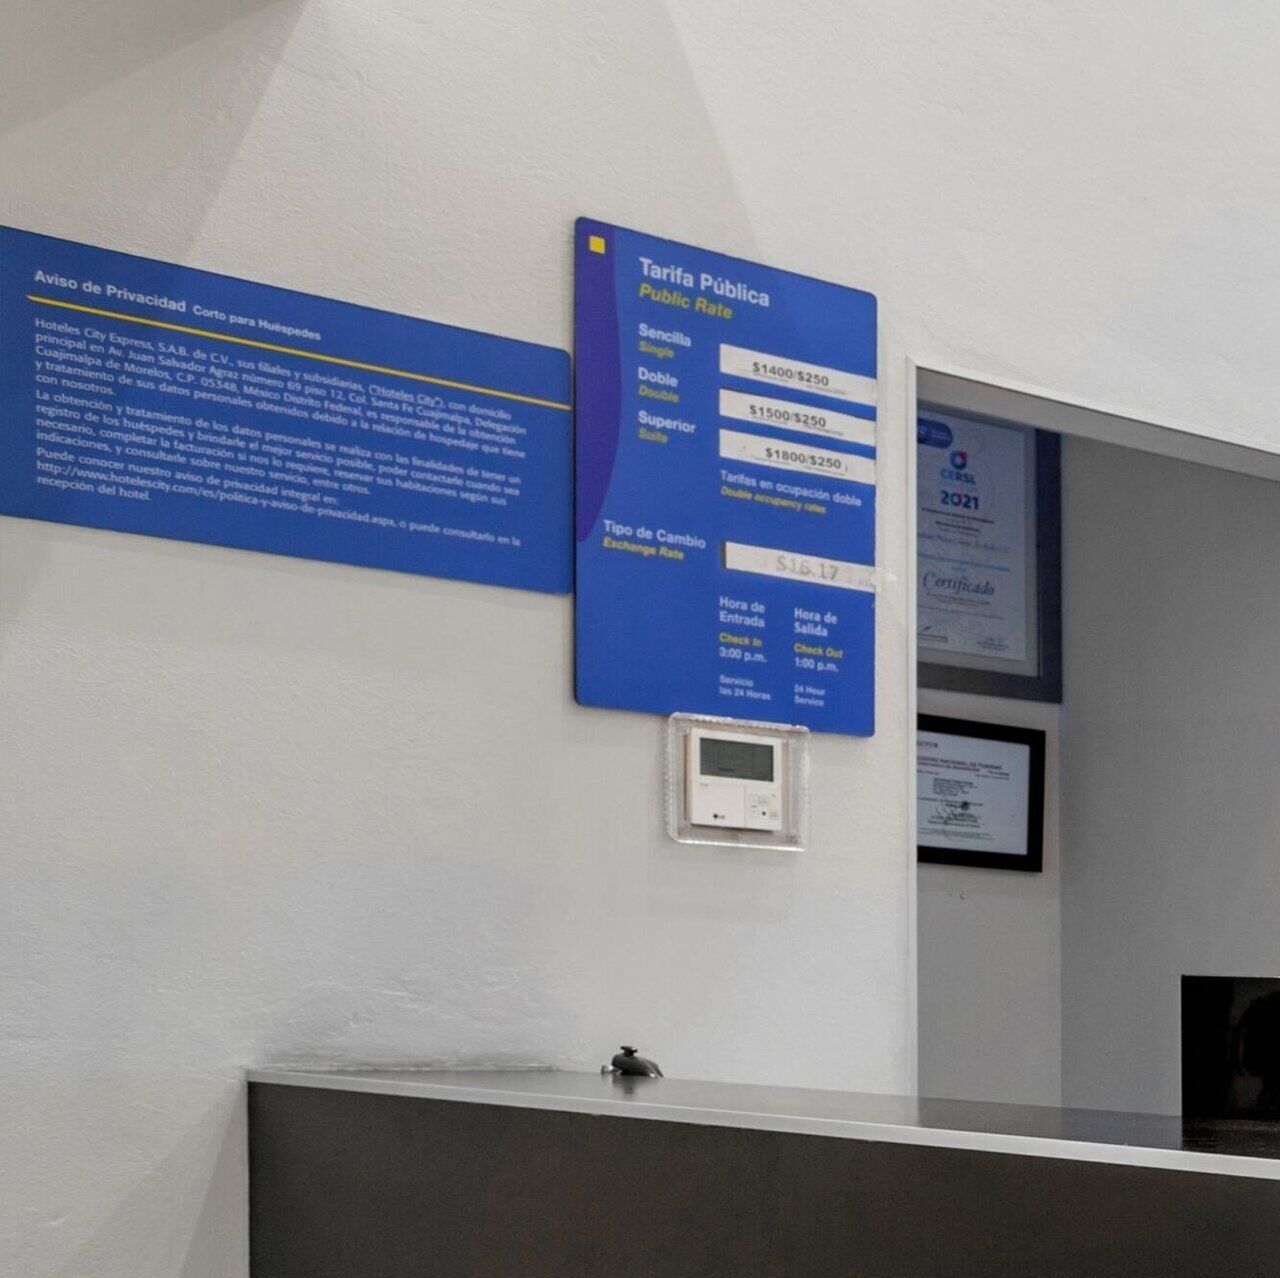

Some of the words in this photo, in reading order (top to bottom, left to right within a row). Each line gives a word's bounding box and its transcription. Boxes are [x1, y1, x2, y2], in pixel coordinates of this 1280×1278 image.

[639, 256, 694, 288] Tarifa
[700, 272, 770, 307] Pública
[36, 271, 77, 290] Aviso
[83, 281, 102, 295] de
[106, 286, 186, 313] Privacidad
[193, 306, 226, 321] Corto
[229, 316, 256, 327] para
[258, 319, 321, 340] Huéspedes
[640, 282, 690, 309] Public
[695, 297, 732, 320] Rate
[639, 323, 691, 347] Sencilla
[36, 319, 81, 335] Hoteles
[84, 328, 106, 342] City
[193, 350, 207, 360] de
[237, 361, 256, 370] sus
[258, 363, 291, 377] filiales
[639, 339, 675, 361] Single
[36, 334, 87, 350] principal
[89, 345, 105, 353] en
[129, 351, 155, 363] Juan
[158, 356, 206, 373] Salvador
[209, 366, 239, 379] Agraz
[242, 374, 284, 388] número
[36, 346, 102, 367] Cuajimalpa
[104, 359, 121, 370] de
[243, 386, 281, 400] México
[36, 375, 58, 385] con
[638, 367, 678, 388] Doble
[45, 361, 115, 382] tratamiento
[118, 375, 134, 385] de
[137, 380, 156, 390] sus
[158, 383, 191, 396] datos
[194, 391, 253, 408] personales
[639, 384, 679, 404] Double
[37, 390, 50, 400] La
[53, 394, 113, 411] obtención
[126, 406, 192, 426] tratamiento
[196, 419, 210, 429] de
[212, 422, 229, 432] los
[232, 425, 262, 438] datos
[639, 410, 696, 434] Superior
[37, 406, 81, 419] registro
[84, 412, 99, 422] de
[102, 415, 121, 426] los
[122, 419, 185, 437] huéspedes
[197, 432, 246, 448] brindarle
[249, 443, 259, 451] el
[261, 446, 292, 456] mejor
[639, 427, 669, 444] Suite
[99, 430, 158, 446] completar
[160, 439, 170, 448] la
[173, 441, 235, 459] facturación
[249, 456, 270, 465] nos
[272, 458, 283, 467] lo
[38, 448, 75, 461] Puede
[79, 456, 125, 470] conocer
[128, 465, 172, 478] nuestro
[175, 473, 203, 483] aviso
[206, 476, 221, 486] de
[224, 481, 278, 495] privacidad
[125, 448, 187, 464] consultarle
[190, 459, 222, 470] sobre
[224, 465, 266, 477] nuestro
[38, 477, 94, 492] recepción
[97, 485, 116, 495] del
[721, 470, 756, 487] Tarifas
[759, 480, 773, 491] en
[776, 482, 829, 502] ocupación
[833, 491, 862, 507] doble
[940, 490, 979, 510] 2021
[604, 519, 632, 537] Tipo
[637, 526, 652, 540] de
[656, 529, 706, 549] Cambio
[604, 536, 656, 556] Exchange
[659, 546, 684, 559] Rate
[922, 571, 995, 596] Certificado
[720, 596, 747, 611] Hora
[751, 601, 765, 614] de
[794, 607, 820, 622] Hora
[824, 611, 838, 625] de
[720, 611, 765, 628] Entrada
[794, 621, 828, 637] Salida
[720, 633, 749, 645] Check
[719, 646, 741, 659] 3:00
[744, 651, 767, 664] p.m.
[794, 643, 822, 656] Check
[826, 647, 843, 658] Out
[795, 657, 814, 669] 1:00
[817, 661, 839, 673] p.m.
[720, 675, 753, 688] Servicio
[794, 684, 804, 694] 24
[806, 686, 825, 696] Hour
[720, 686, 732, 695] las
[734, 688, 744, 697] 24
[746, 690, 771, 701] Horas
[794, 696, 824, 707] Service
